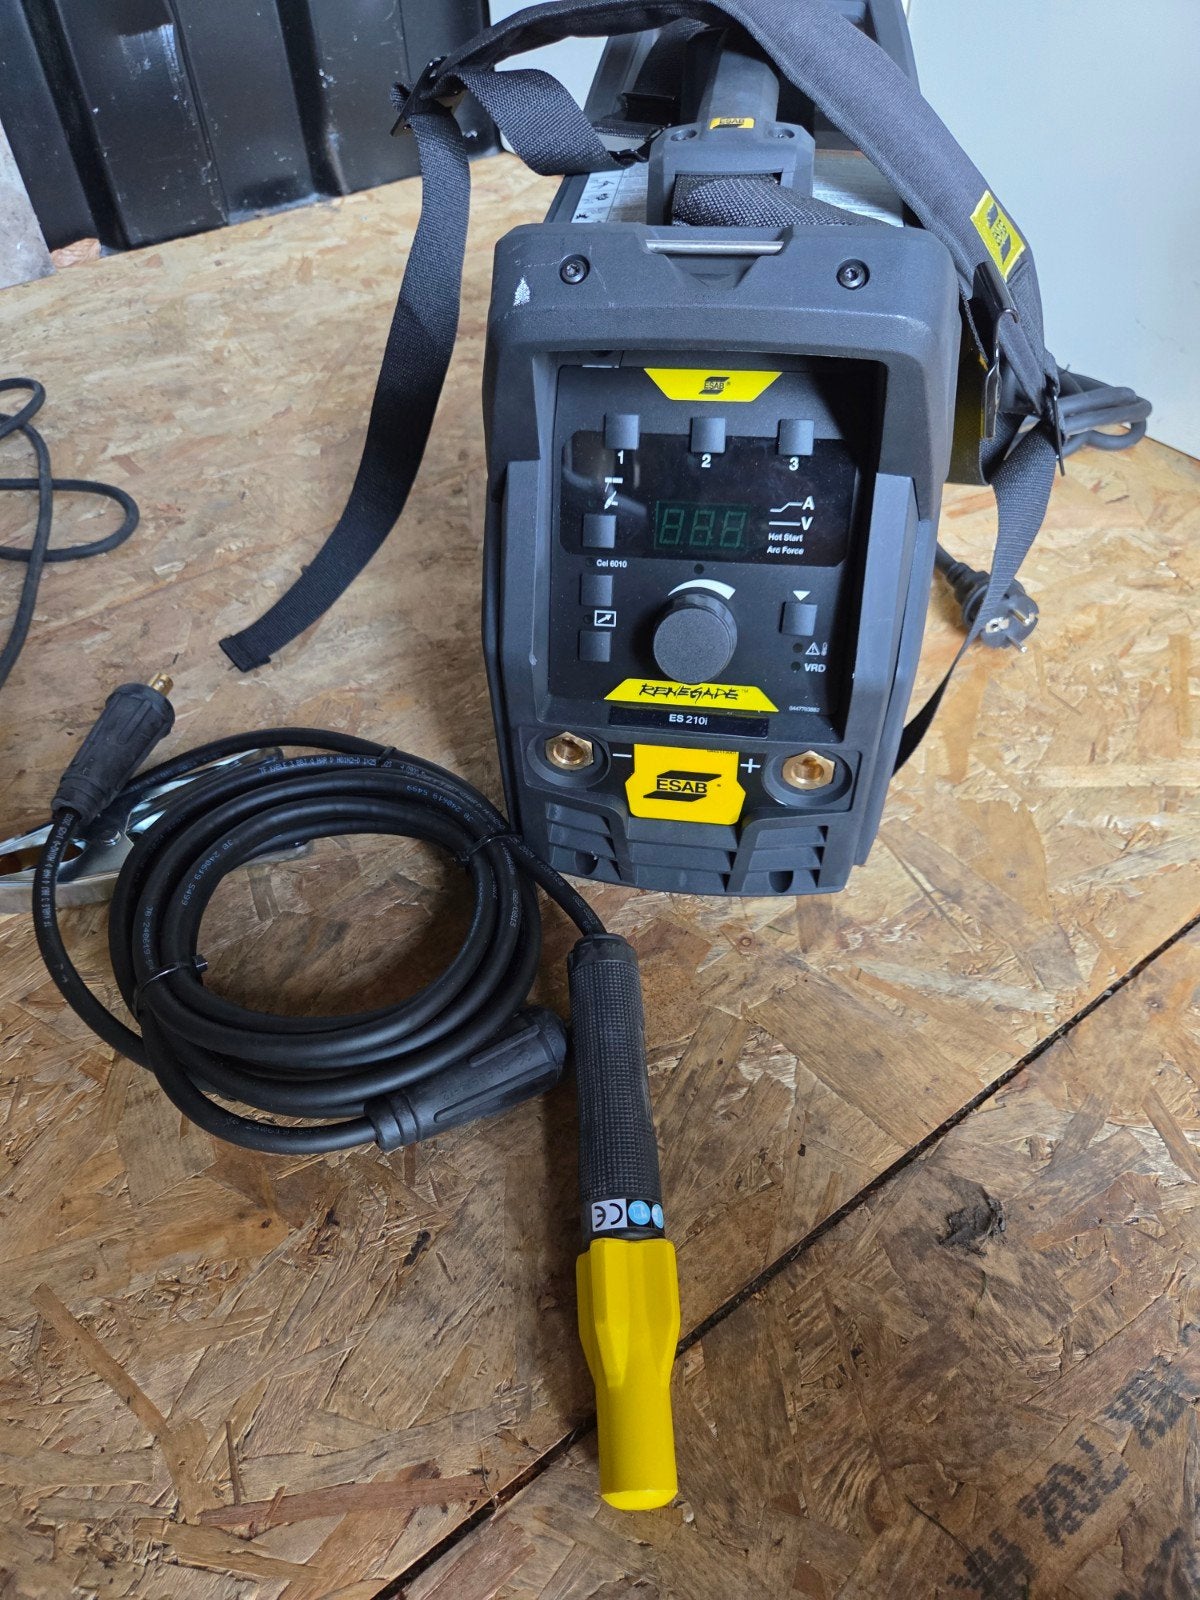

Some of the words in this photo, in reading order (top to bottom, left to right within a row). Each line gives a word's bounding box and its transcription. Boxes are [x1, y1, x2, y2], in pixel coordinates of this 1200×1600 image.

[704, 381, 725, 391] ESAB
[617, 450, 624, 464] 1
[701, 453, 712, 468] 2
[788, 456, 799, 471] 3
[802, 496, 815, 510] A
[801, 516, 814, 531] V
[768, 532, 783, 541] Hot
[783, 533, 804, 542] Start
[767, 545, 781, 554] Arc
[782, 546, 805, 555] Force
[596, 558, 609, 567] Cel
[610, 559, 628, 568] 6010
[804, 662, 826, 673] VRD
[639, 683, 739, 704] RENEGADE
[669, 713, 684, 723] ES
[686, 715, 708, 726] 210i
[656, 779, 707, 794] ESAB
